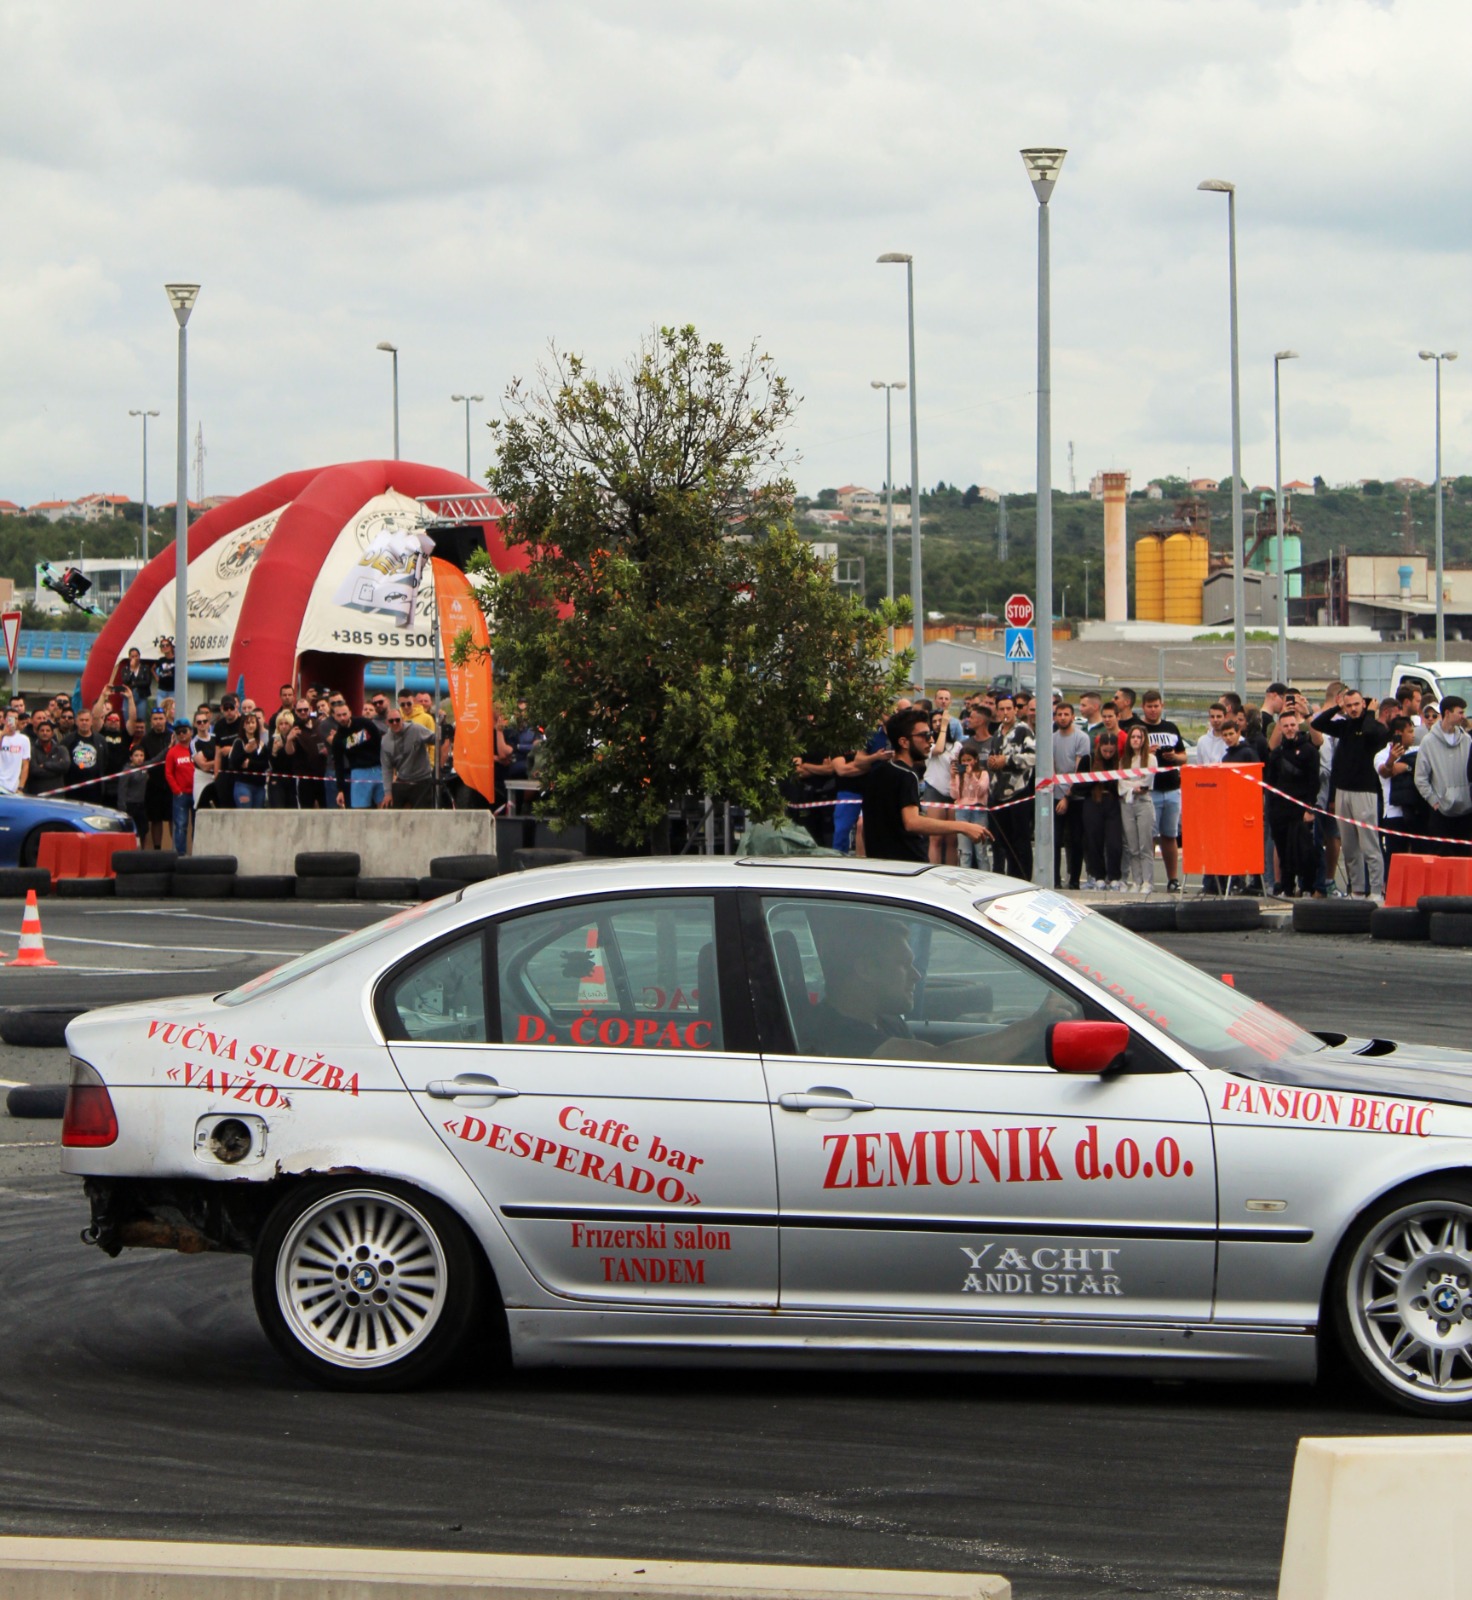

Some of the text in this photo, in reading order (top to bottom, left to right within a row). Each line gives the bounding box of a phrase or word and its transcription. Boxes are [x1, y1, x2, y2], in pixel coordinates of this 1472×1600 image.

[1007, 604, 1032, 619] STOP
[190, 635, 206, 650] 506
[331, 629, 373, 645] +385
[377, 633, 400, 646] 95
[515, 1008, 713, 1050] D. ČOPAC
[147, 1019, 360, 1098] VUČNA SLUŽBA
[1221, 1081, 1435, 1139] PANSION BEGIĆ
[558, 1105, 705, 1176] Caffe bar
[822, 1124, 1195, 1190] ZEMUNIK d.o.o.
[673, 1224, 732, 1250] salon
[600, 1256, 706, 1284] TANDEM
[959, 1242, 1121, 1272] YACHT
[961, 1273, 1124, 1296] ANDI STAR
